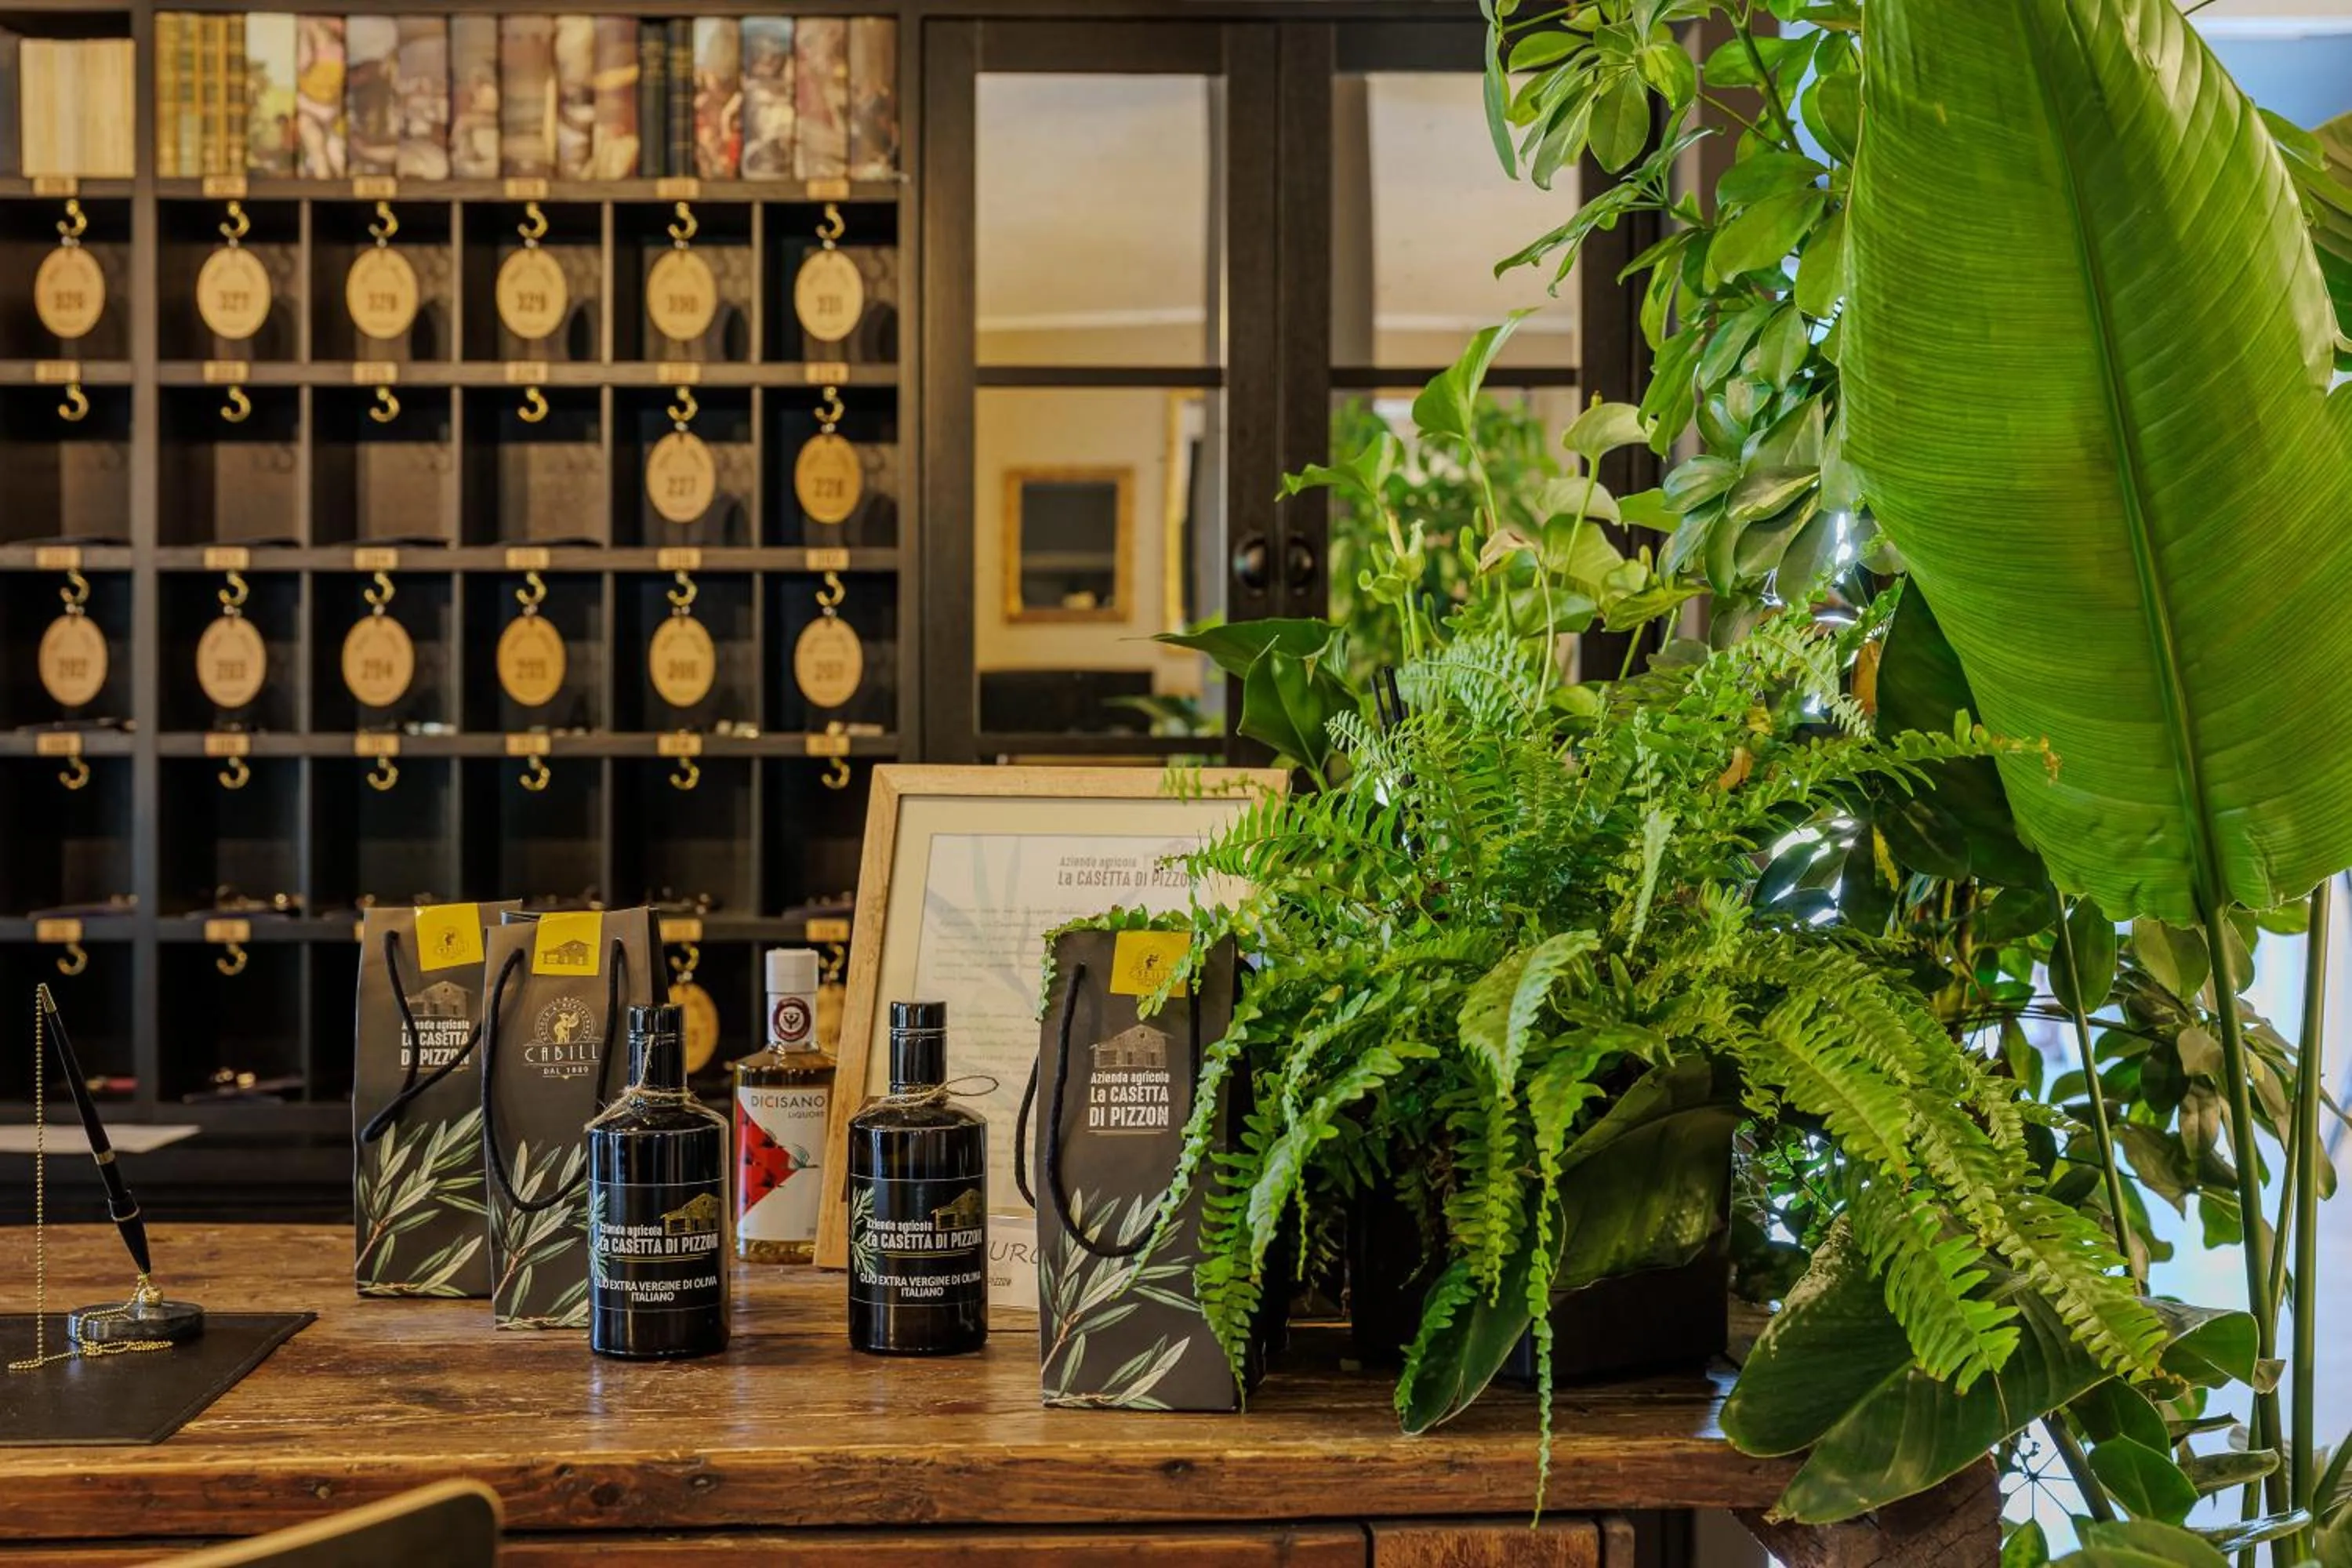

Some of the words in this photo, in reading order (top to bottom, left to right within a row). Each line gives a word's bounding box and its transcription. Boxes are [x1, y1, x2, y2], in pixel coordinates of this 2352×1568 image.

[668, 477, 696, 496] 227
[1098, 856, 1137, 869] agricola
[1058, 870, 1073, 886] La
[1077, 871, 1131, 887] CASETTA
[1135, 871, 1147, 887] DI
[1152, 871, 1190, 887] PIZZO
[419, 1032, 468, 1047] CASETTA
[524, 1044, 601, 1062] CABILL
[1091, 1072, 1128, 1084] Azienda
[1130, 1070, 1170, 1086] agricola
[750, 1095, 825, 1108] DICISANO
[1091, 1086, 1106, 1103] La
[1109, 1086, 1169, 1102] CASETTA
[1089, 1106, 1105, 1127] DI
[1109, 1105, 1169, 1127] PIZZON
[612, 1238, 662, 1254] CASETTA
[666, 1237, 678, 1254] DI
[880, 1233, 933, 1250] CASETTA
[936, 1233, 948, 1249] DI
[609, 1279, 637, 1291] EXTRA
[639, 1280, 681, 1291] VERGINE
[683, 1279, 692, 1290] DI
[878, 1275, 907, 1287] EXTRA
[909, 1275, 950, 1287] VERGINE
[952, 1274, 960, 1285] DI
[631, 1291, 675, 1302] ITALIANO
[901, 1287, 944, 1298] ITALIANO
